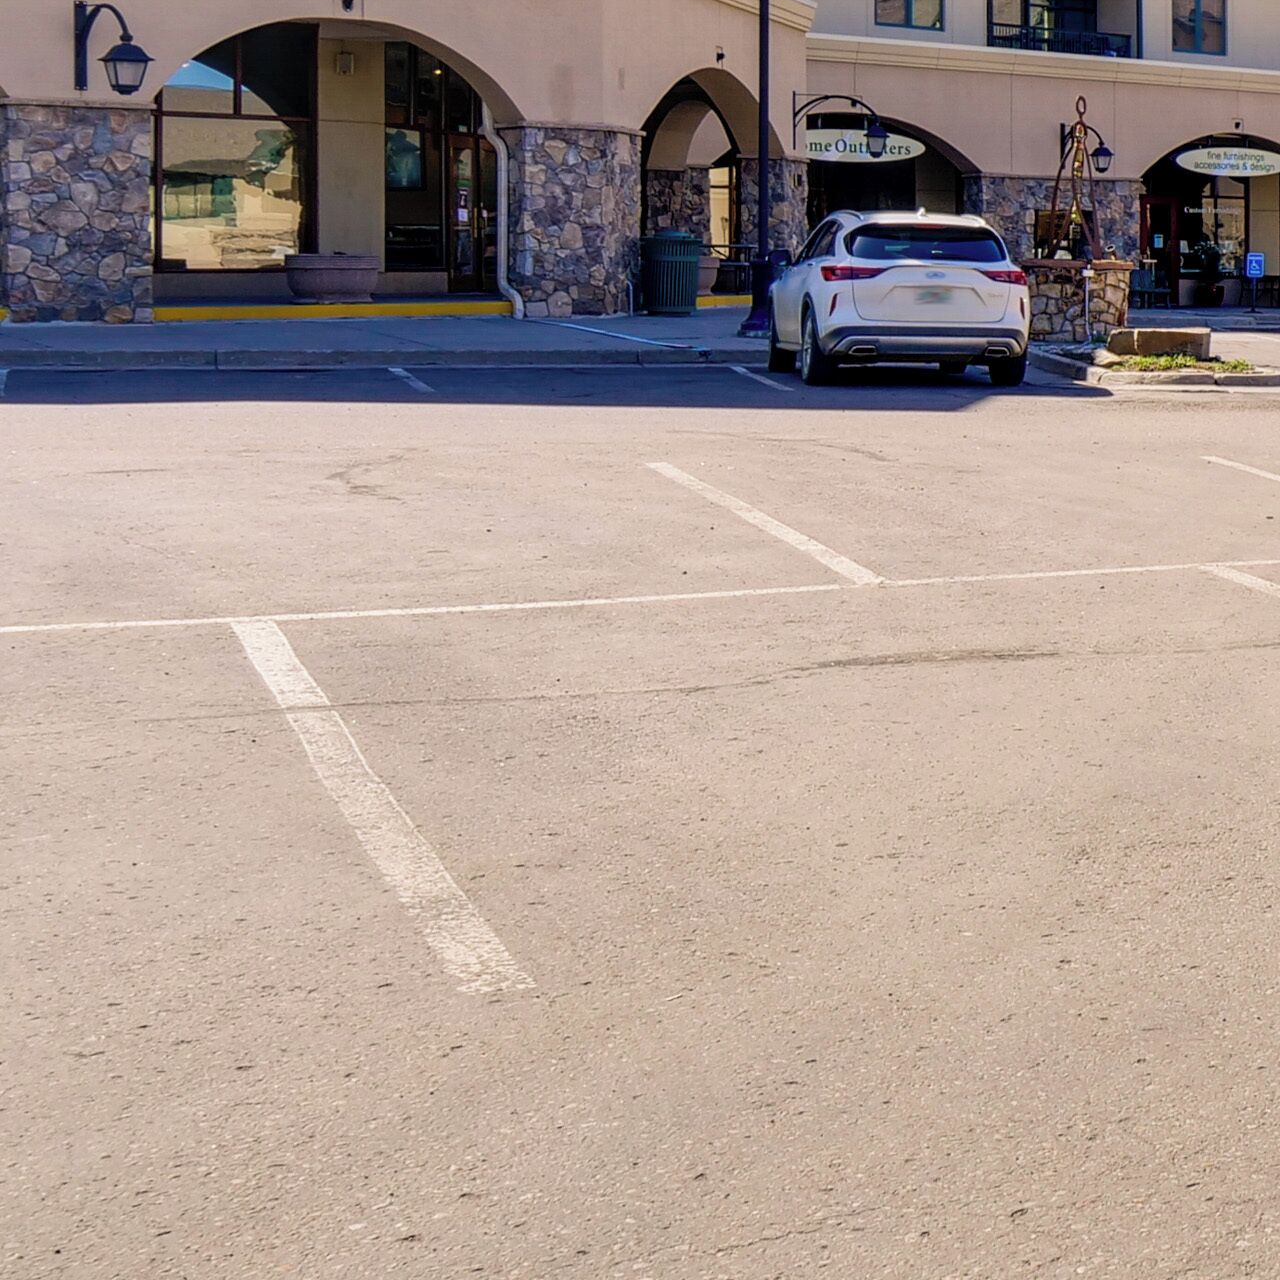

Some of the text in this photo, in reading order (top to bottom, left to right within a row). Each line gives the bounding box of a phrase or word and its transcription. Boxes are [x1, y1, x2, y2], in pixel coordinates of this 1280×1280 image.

[1207, 151, 1264, 162] fine furnishings
[1194, 161, 1276, 173] accessories & design
